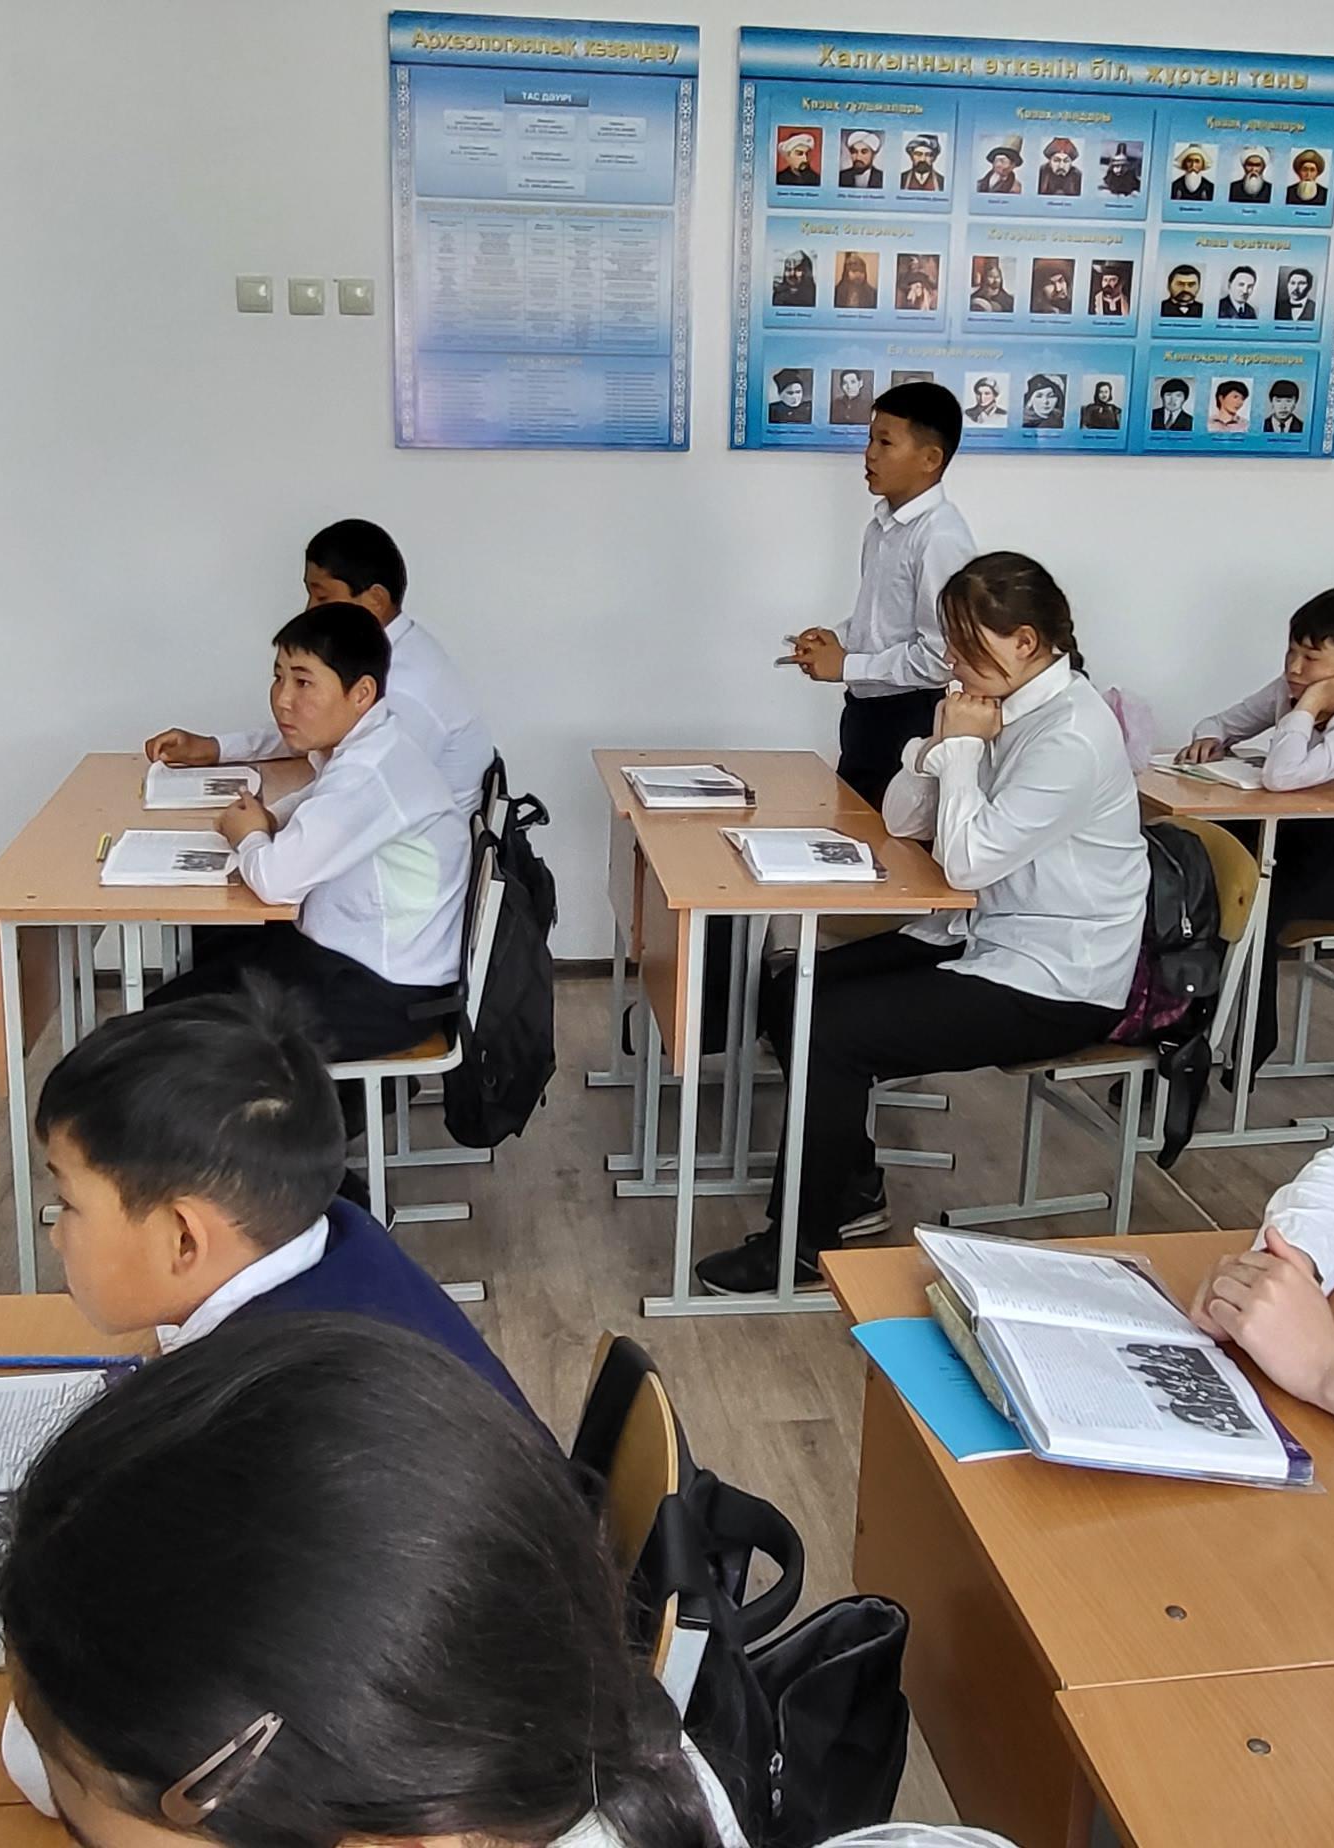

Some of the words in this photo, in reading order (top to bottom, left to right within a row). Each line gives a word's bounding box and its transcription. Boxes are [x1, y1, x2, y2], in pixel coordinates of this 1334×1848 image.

[412, 29, 577, 58] Археологиялық
[984, 57, 1079, 79] өткенін
[1090, 57, 1133, 85] біл,
[1250, 70, 1310, 91] таны
[521, 91, 540, 102] ТАС
[801, 96, 841, 114] Қазақ
[1016, 106, 1052, 121] Қазақ
